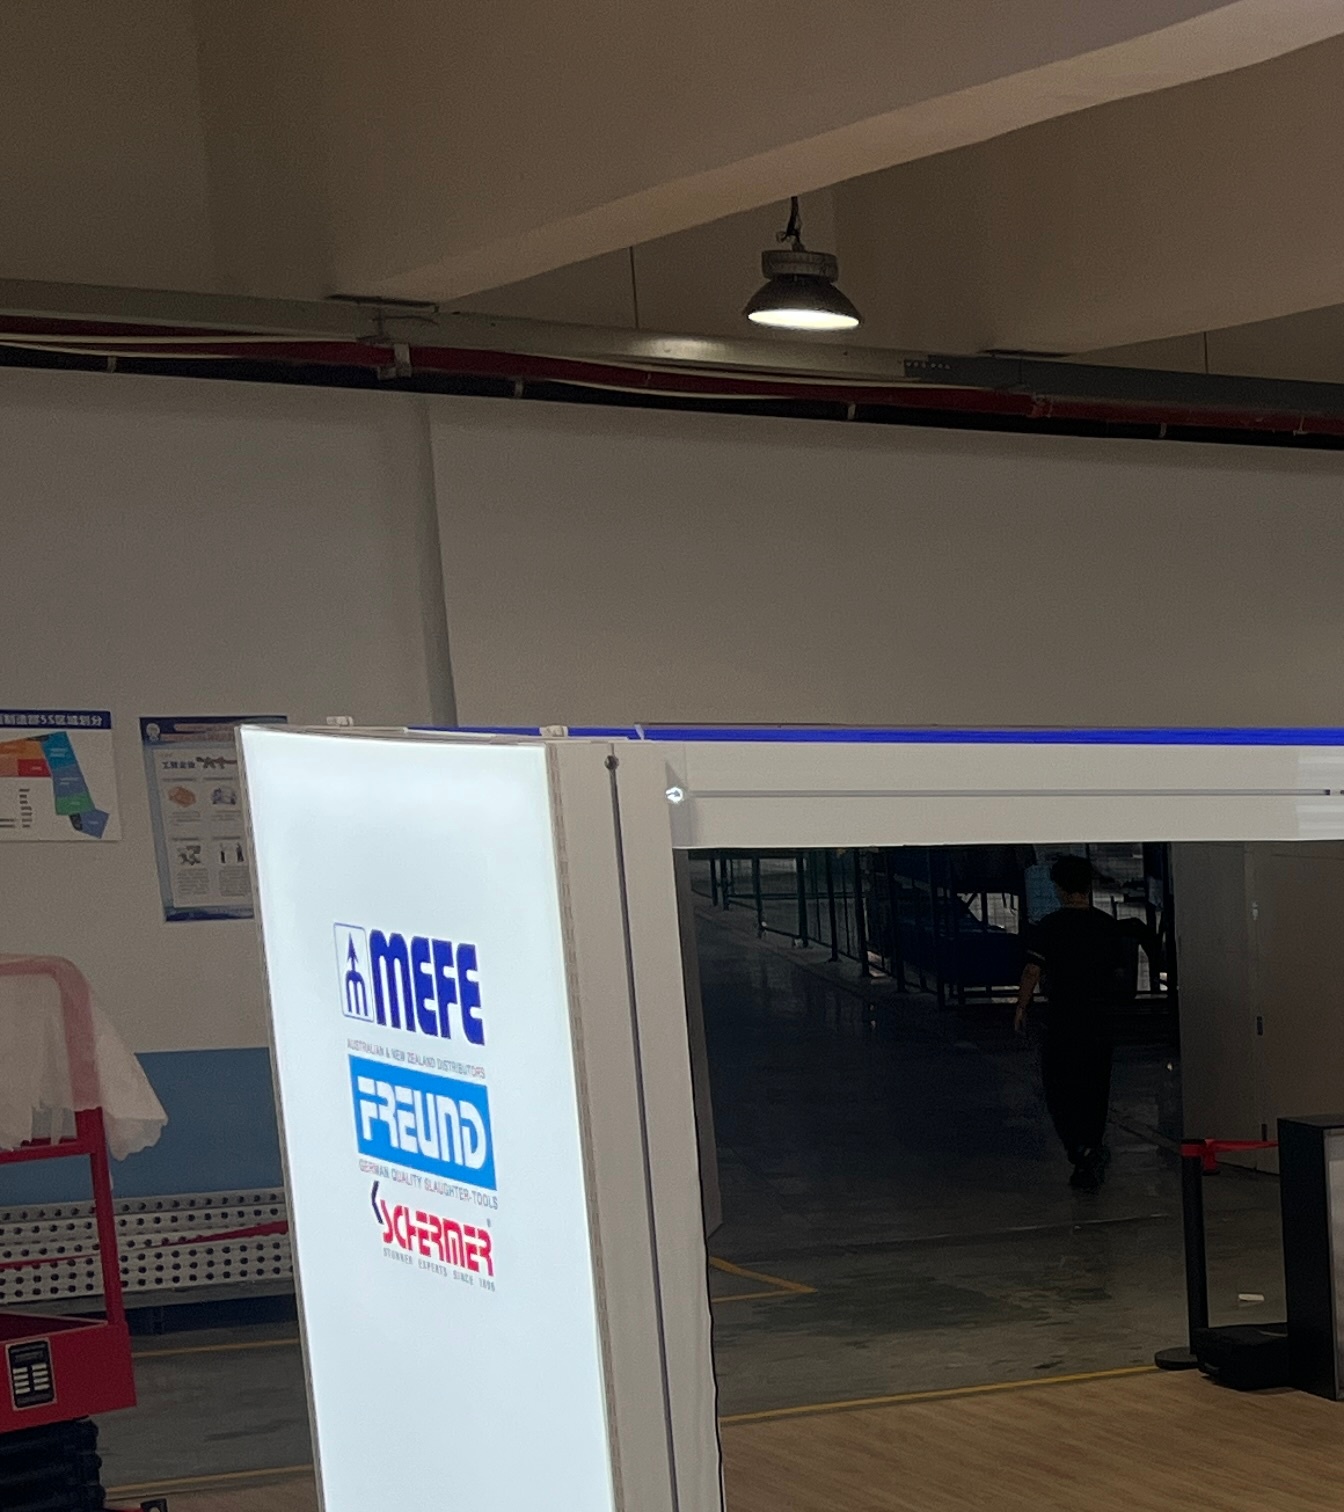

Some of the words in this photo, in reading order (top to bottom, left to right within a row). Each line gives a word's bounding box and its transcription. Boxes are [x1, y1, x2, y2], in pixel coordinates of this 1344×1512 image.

[370, 929, 485, 1046] MEFE
[357, 1075, 487, 1170] FREUND
[378, 1199, 495, 1277] SCHERMER
